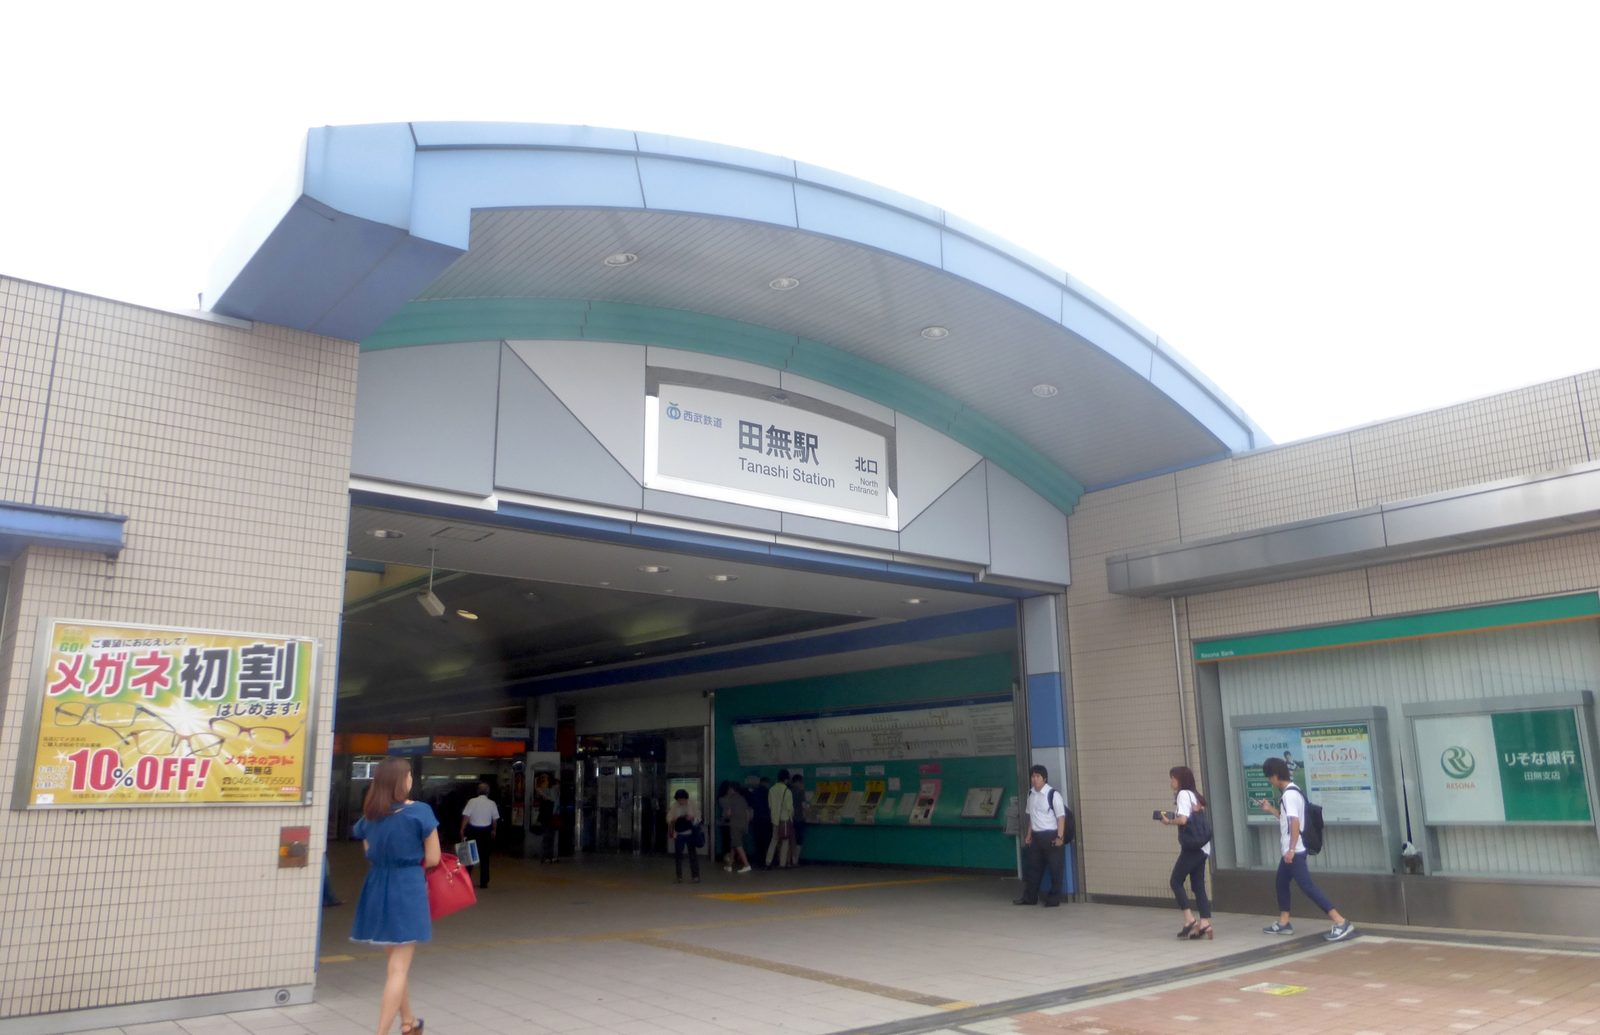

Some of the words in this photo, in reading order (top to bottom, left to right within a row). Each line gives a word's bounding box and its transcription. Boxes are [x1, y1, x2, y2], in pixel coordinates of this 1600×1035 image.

[683, 410, 723, 429] 西武鉄道
[738, 420, 820, 466] 田無駅
[738, 456, 789, 480] Tanashi
[792, 469, 836, 489] Station
[855, 456, 878, 475] 北口
[849, 484, 879, 496] Entrance
[860, 477, 879, 488] North
[1504, 750, 1576, 766] りそな銀行
[1524, 771, 1561, 781] 田無支店
[1445, 782, 1476, 790] RESONA
